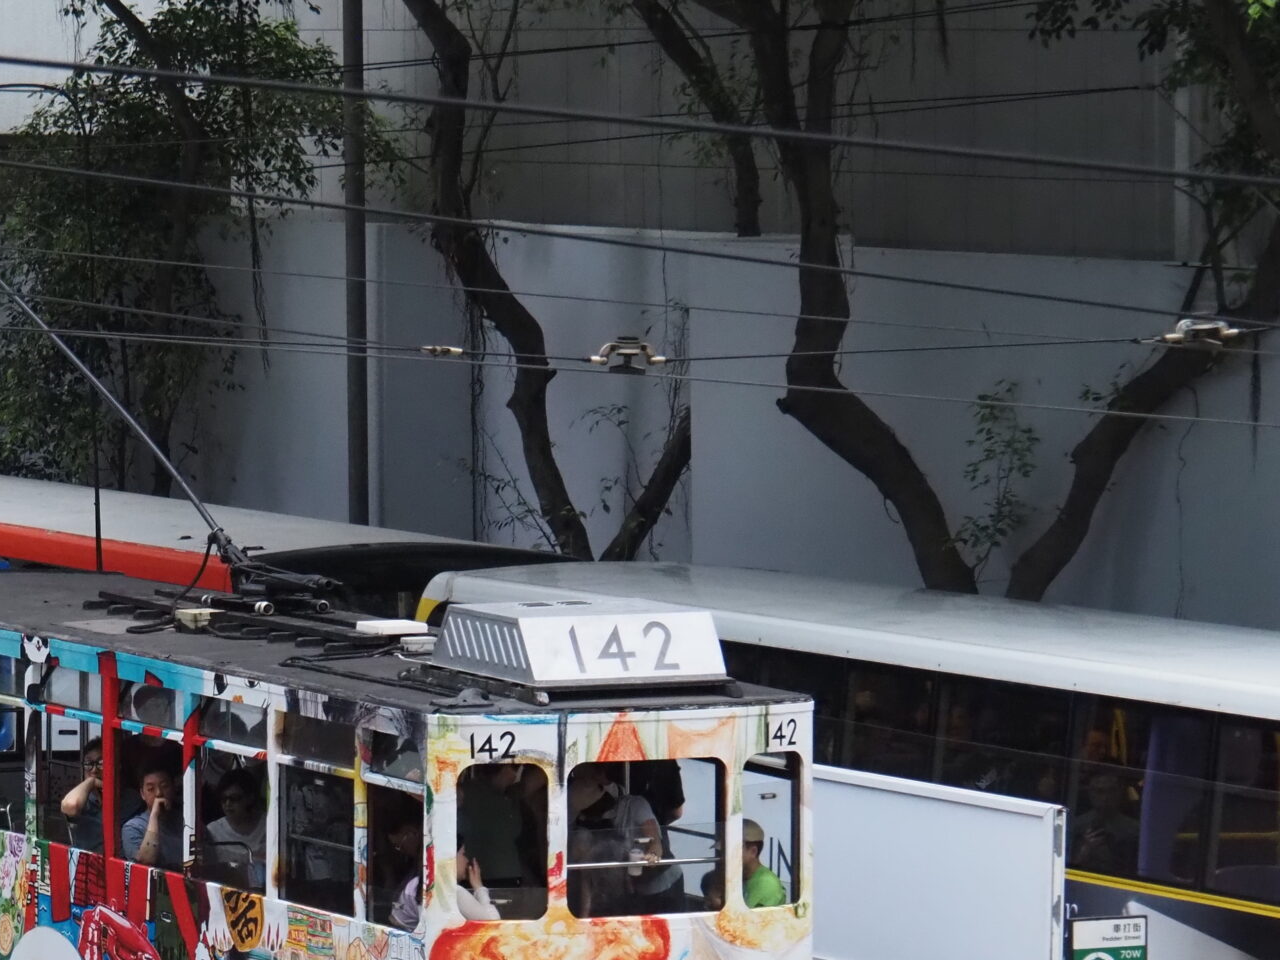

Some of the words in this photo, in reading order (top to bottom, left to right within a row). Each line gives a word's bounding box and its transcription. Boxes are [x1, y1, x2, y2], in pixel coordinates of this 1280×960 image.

[568, 620, 681, 674] 142
[469, 731, 517, 760] 142
[766, 718, 798, 748] 142
[1120, 950, 1142, 959] 70W
